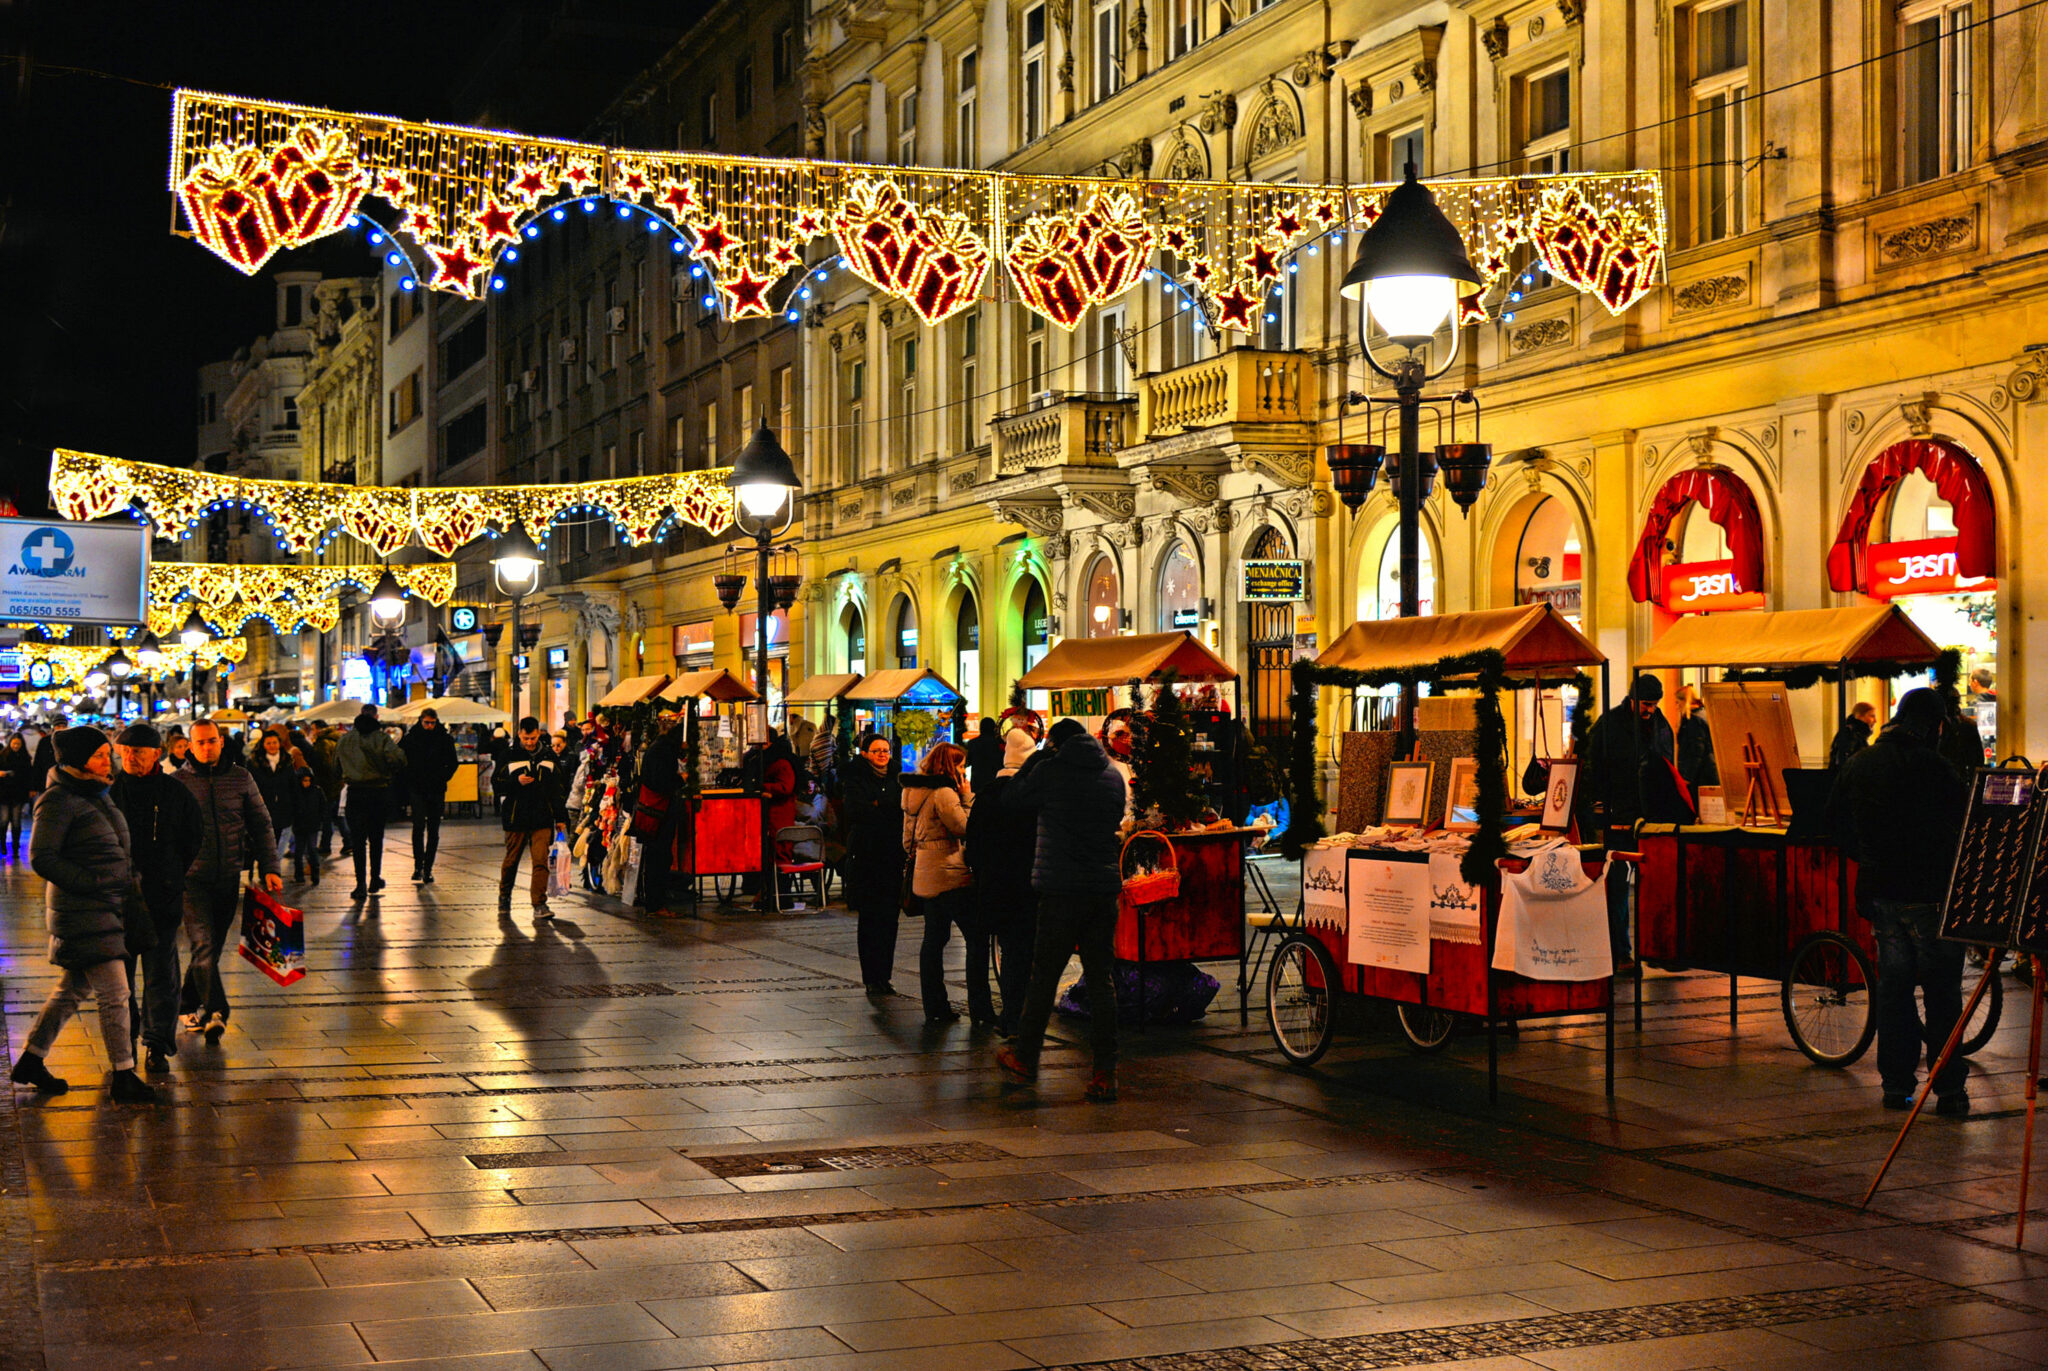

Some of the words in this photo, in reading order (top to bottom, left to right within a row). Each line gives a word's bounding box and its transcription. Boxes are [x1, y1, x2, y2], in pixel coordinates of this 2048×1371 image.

[1247, 565, 1299, 578] MENJAČNICA
[9, 605, 52, 616] 065/550
[55, 606, 81, 617] 5555
